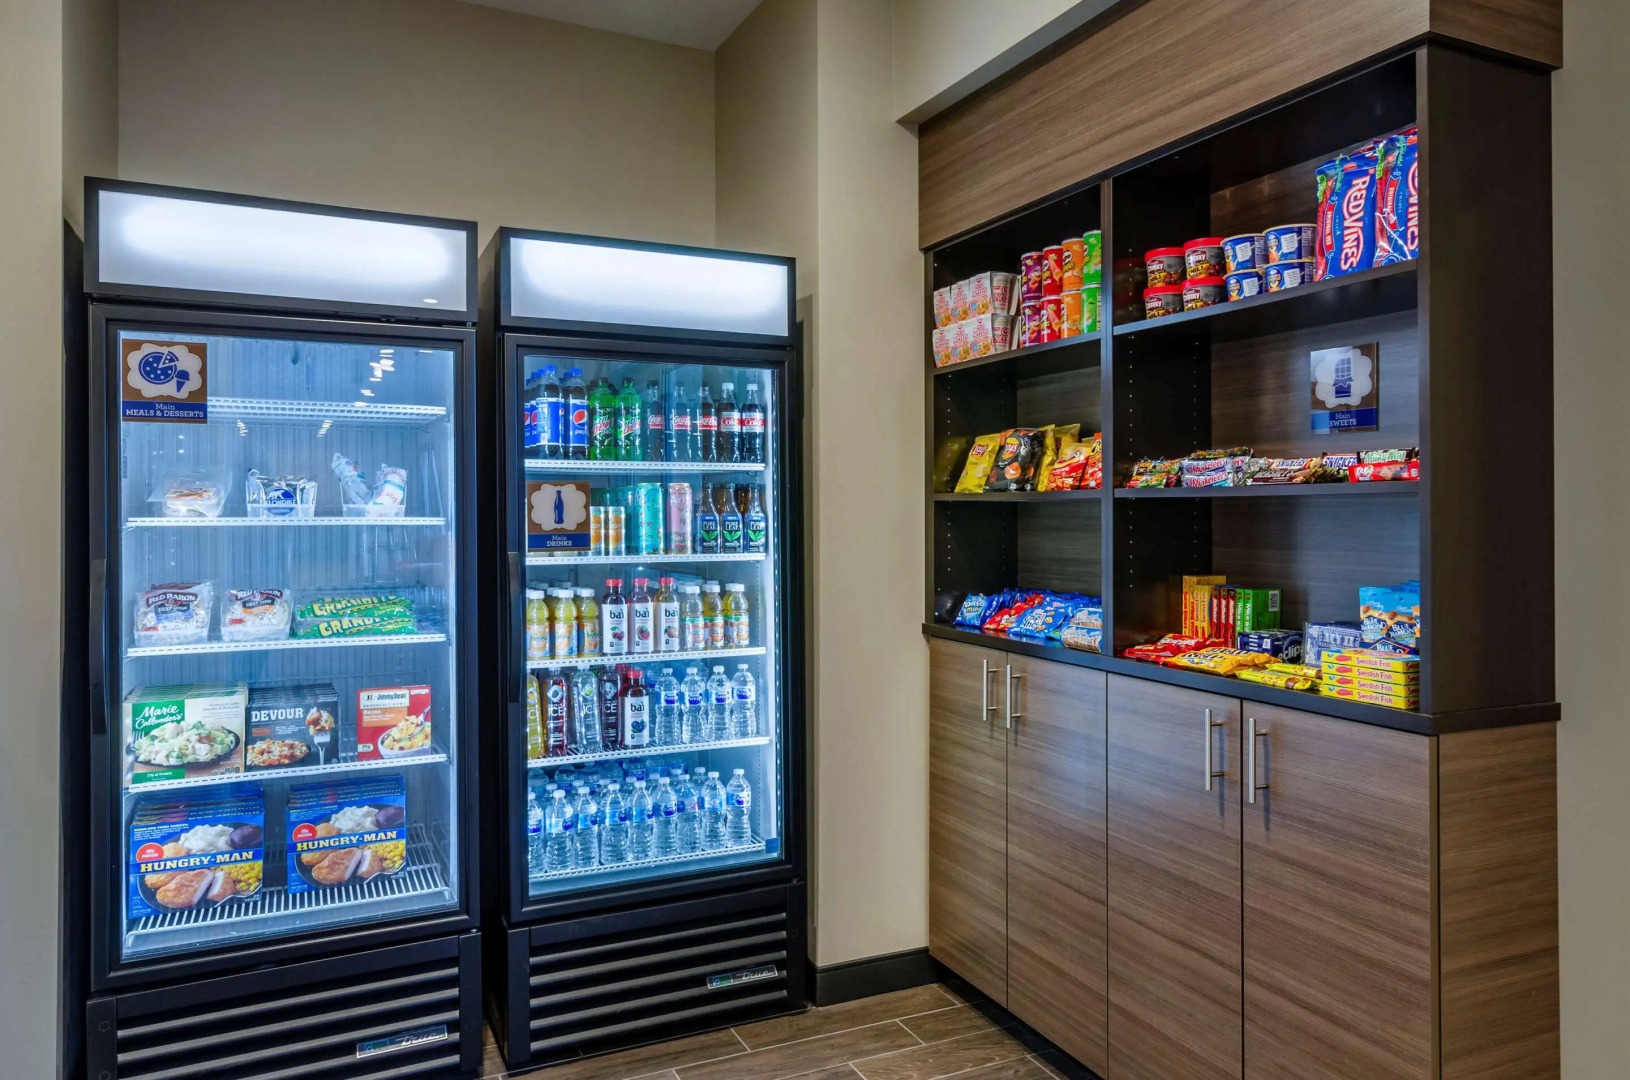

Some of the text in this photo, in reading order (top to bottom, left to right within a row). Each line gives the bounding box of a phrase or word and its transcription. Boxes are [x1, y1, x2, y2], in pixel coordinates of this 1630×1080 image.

[126, 409, 155, 417] MEALS
[163, 410, 204, 418] DESSERTS
[1335, 412, 1351, 420] Main
[1329, 418, 1357, 428] SWEETS
[148, 593, 197, 604] RED BARON
[610, 608, 624, 619] bai
[635, 607, 650, 619] bai
[664, 606, 679, 618] bai
[1392, 623, 1410, 631] BLUE
[1324, 633, 1343, 645] ACT
[1376, 643, 1394, 653] BLUE
[1356, 657, 1392, 668] Swedish Fish
[1357, 669, 1393, 680] Swedish Fish
[1357, 680, 1393, 692] Swedish Fish
[376, 692, 407, 703] Jimmy Dean
[1357, 691, 1393, 705] Swedish Fish
[135, 704, 180, 721] Marie
[630, 702, 645, 713] bai
[251, 707, 304, 722] DEVOUR
[296, 831, 398, 851] HUNGRY-MAN
[139, 851, 254, 873] HUNGRY-MAN
